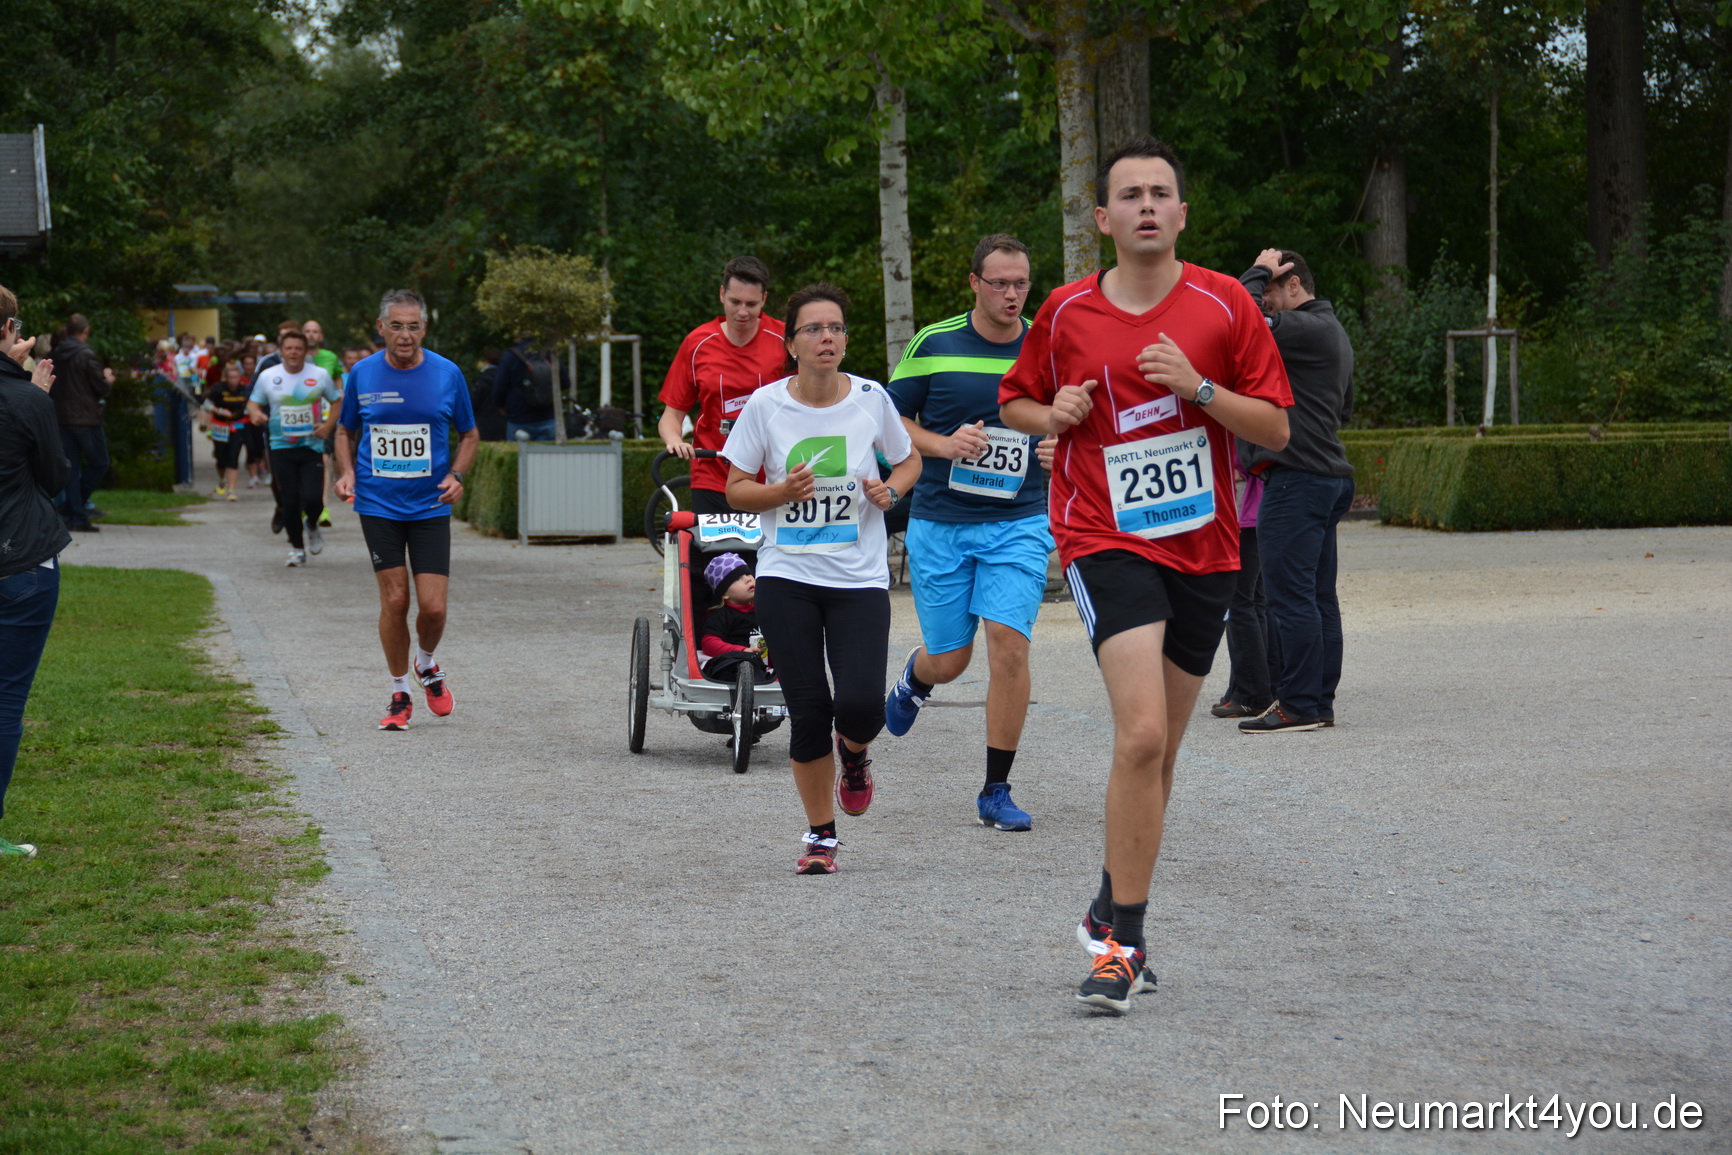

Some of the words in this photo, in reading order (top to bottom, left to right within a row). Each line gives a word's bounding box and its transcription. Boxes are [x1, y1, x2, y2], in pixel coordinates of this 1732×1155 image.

[284, 411, 311, 424] 2345
[1135, 406, 1160, 421] DEHN
[986, 433, 1020, 444] Neumarkt
[377, 437, 425, 457] 3109
[1107, 451, 1143, 466] PARTL
[1144, 440, 1194, 459] Neumarkt
[381, 460, 412, 470] Ernst
[971, 473, 1005, 488] Harald
[1120, 453, 1203, 504] 2361
[785, 495, 852, 523] 3012
[1142, 503, 1197, 525] Thomas
[718, 526, 746, 537] Steffen
[795, 530, 840, 542] Conny
